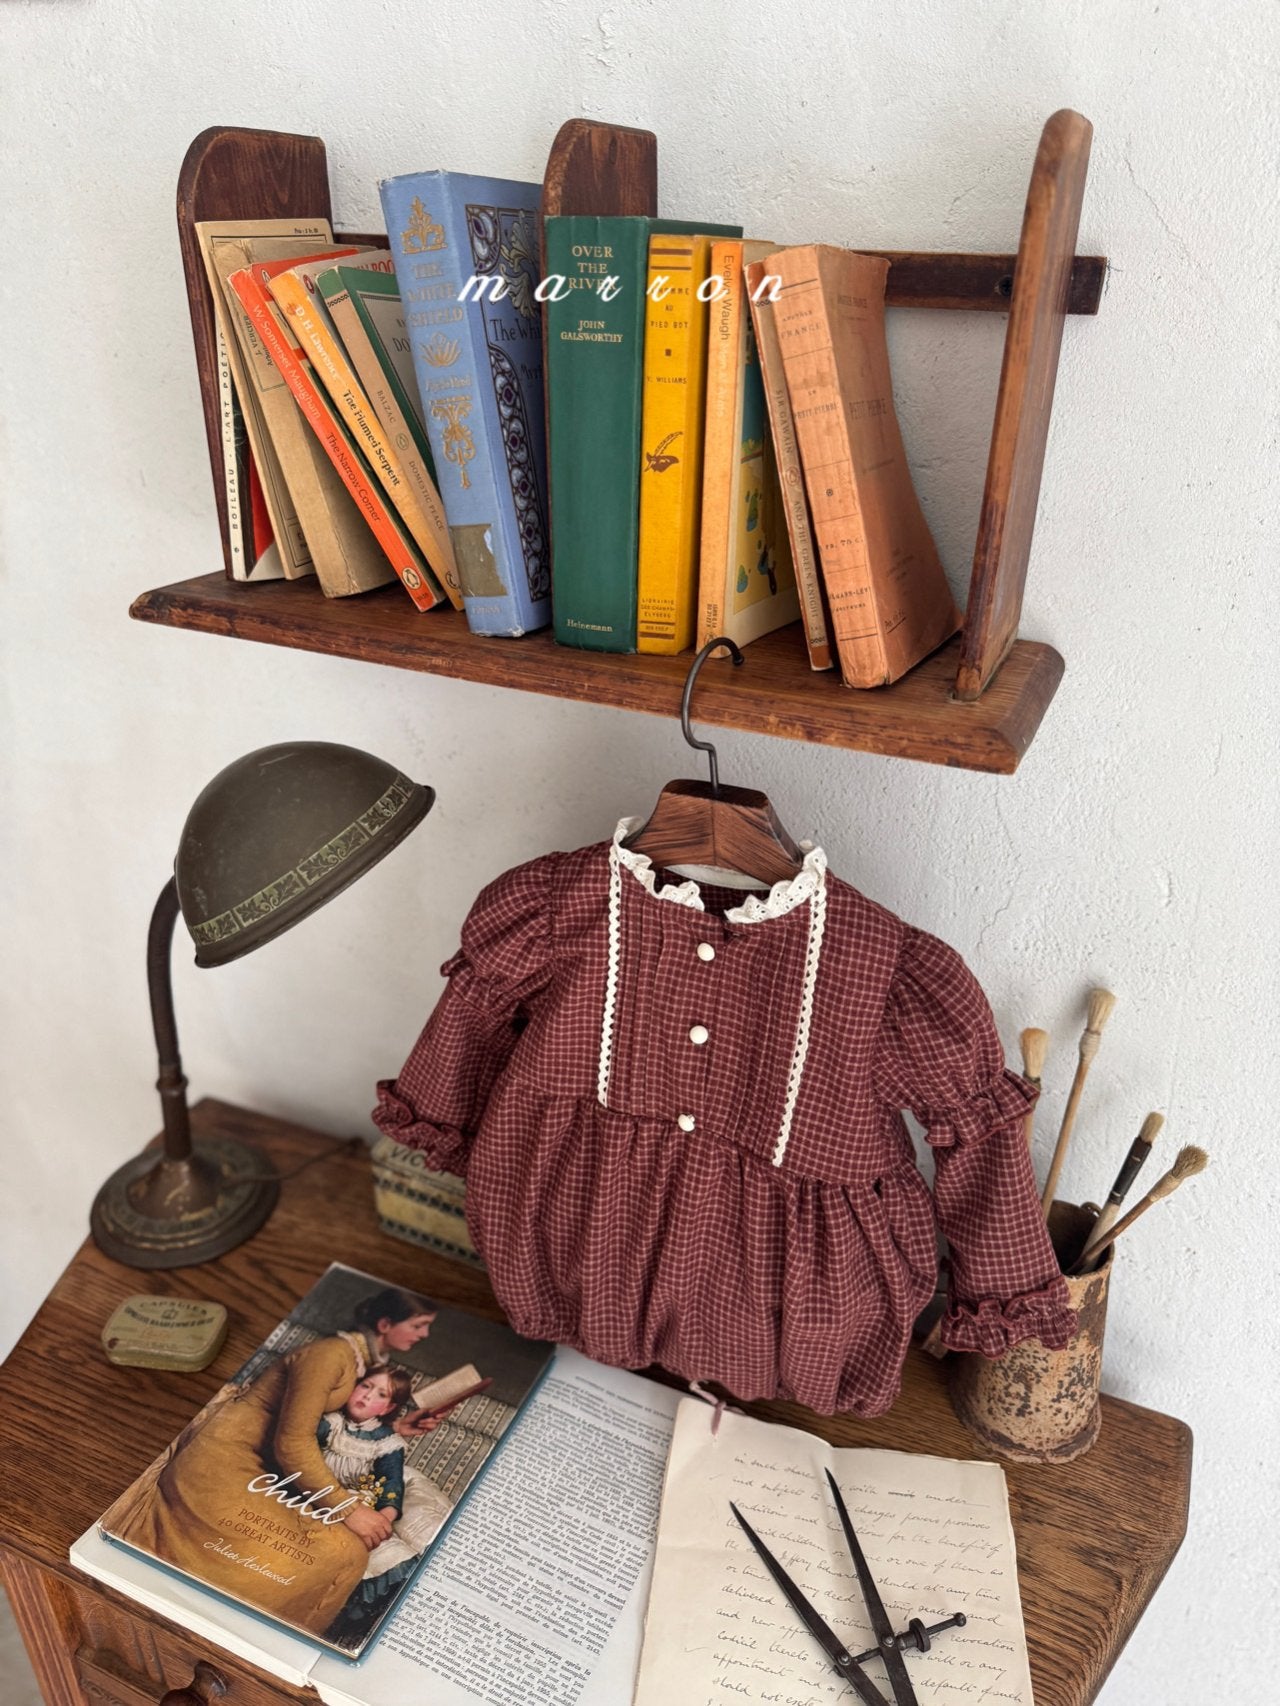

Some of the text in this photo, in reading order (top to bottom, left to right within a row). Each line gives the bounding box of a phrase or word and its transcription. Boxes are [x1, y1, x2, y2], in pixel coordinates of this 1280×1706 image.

[572, 245, 613, 258] OVER
[577, 262, 608, 273] THE
[490, 318, 516, 342] The
[560, 332, 623, 343] GALSWORTHY
[578, 320, 605, 331] JOHN
[719, 299, 733, 341] Waugh
[656, 376, 688, 384] WILLIAMS
[259, 319, 294, 369] Somerset
[286, 367, 323, 420] Maugham
[324, 431, 342, 453] The
[336, 451, 363, 490] Narrow
[357, 488, 382, 523] Corner
[341, 389, 359, 412] The
[352, 410, 380, 449] Plumed
[372, 447, 402, 487] Serpent
[377, 389, 445, 532] BALZAC DOMESTIC PEACE
[228, 468, 238, 529] BOILEAU
[775, 389, 818, 617] SIR GAWAIN AND THE GREEN KNIGHT
[567, 619, 613, 632] Heinemann
[247, 1471, 359, 1525] Child
[217, 1518, 317, 1566] 40 GREAT ARTISTS
[238, 1508, 316, 1549] PORTRAITS BY
[721, 1583, 776, 1606] delivered
[950, 1632, 1016, 1653] revocation
